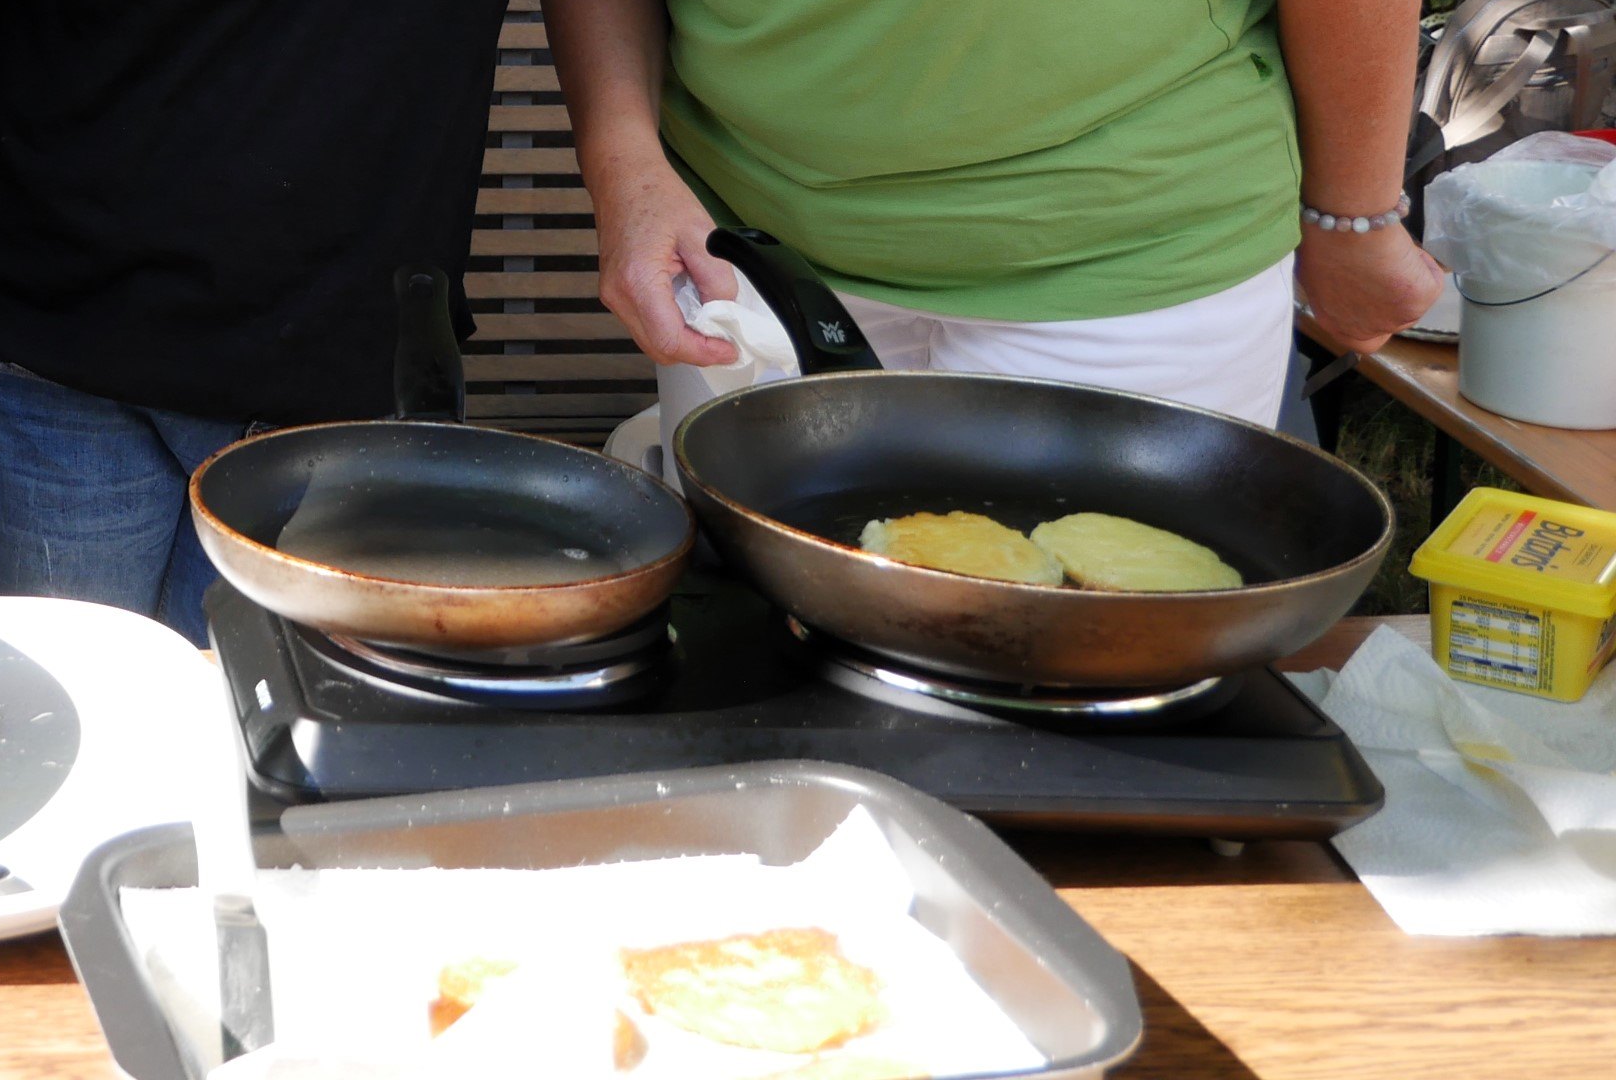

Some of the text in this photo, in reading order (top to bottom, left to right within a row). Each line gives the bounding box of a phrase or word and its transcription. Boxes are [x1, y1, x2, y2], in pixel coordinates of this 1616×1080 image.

[817, 321, 845, 343] WMF
[1511, 520, 1584, 571] Butaris
[1468, 595, 1499, 606] Portionen
[1503, 602, 1530, 613] Packung
